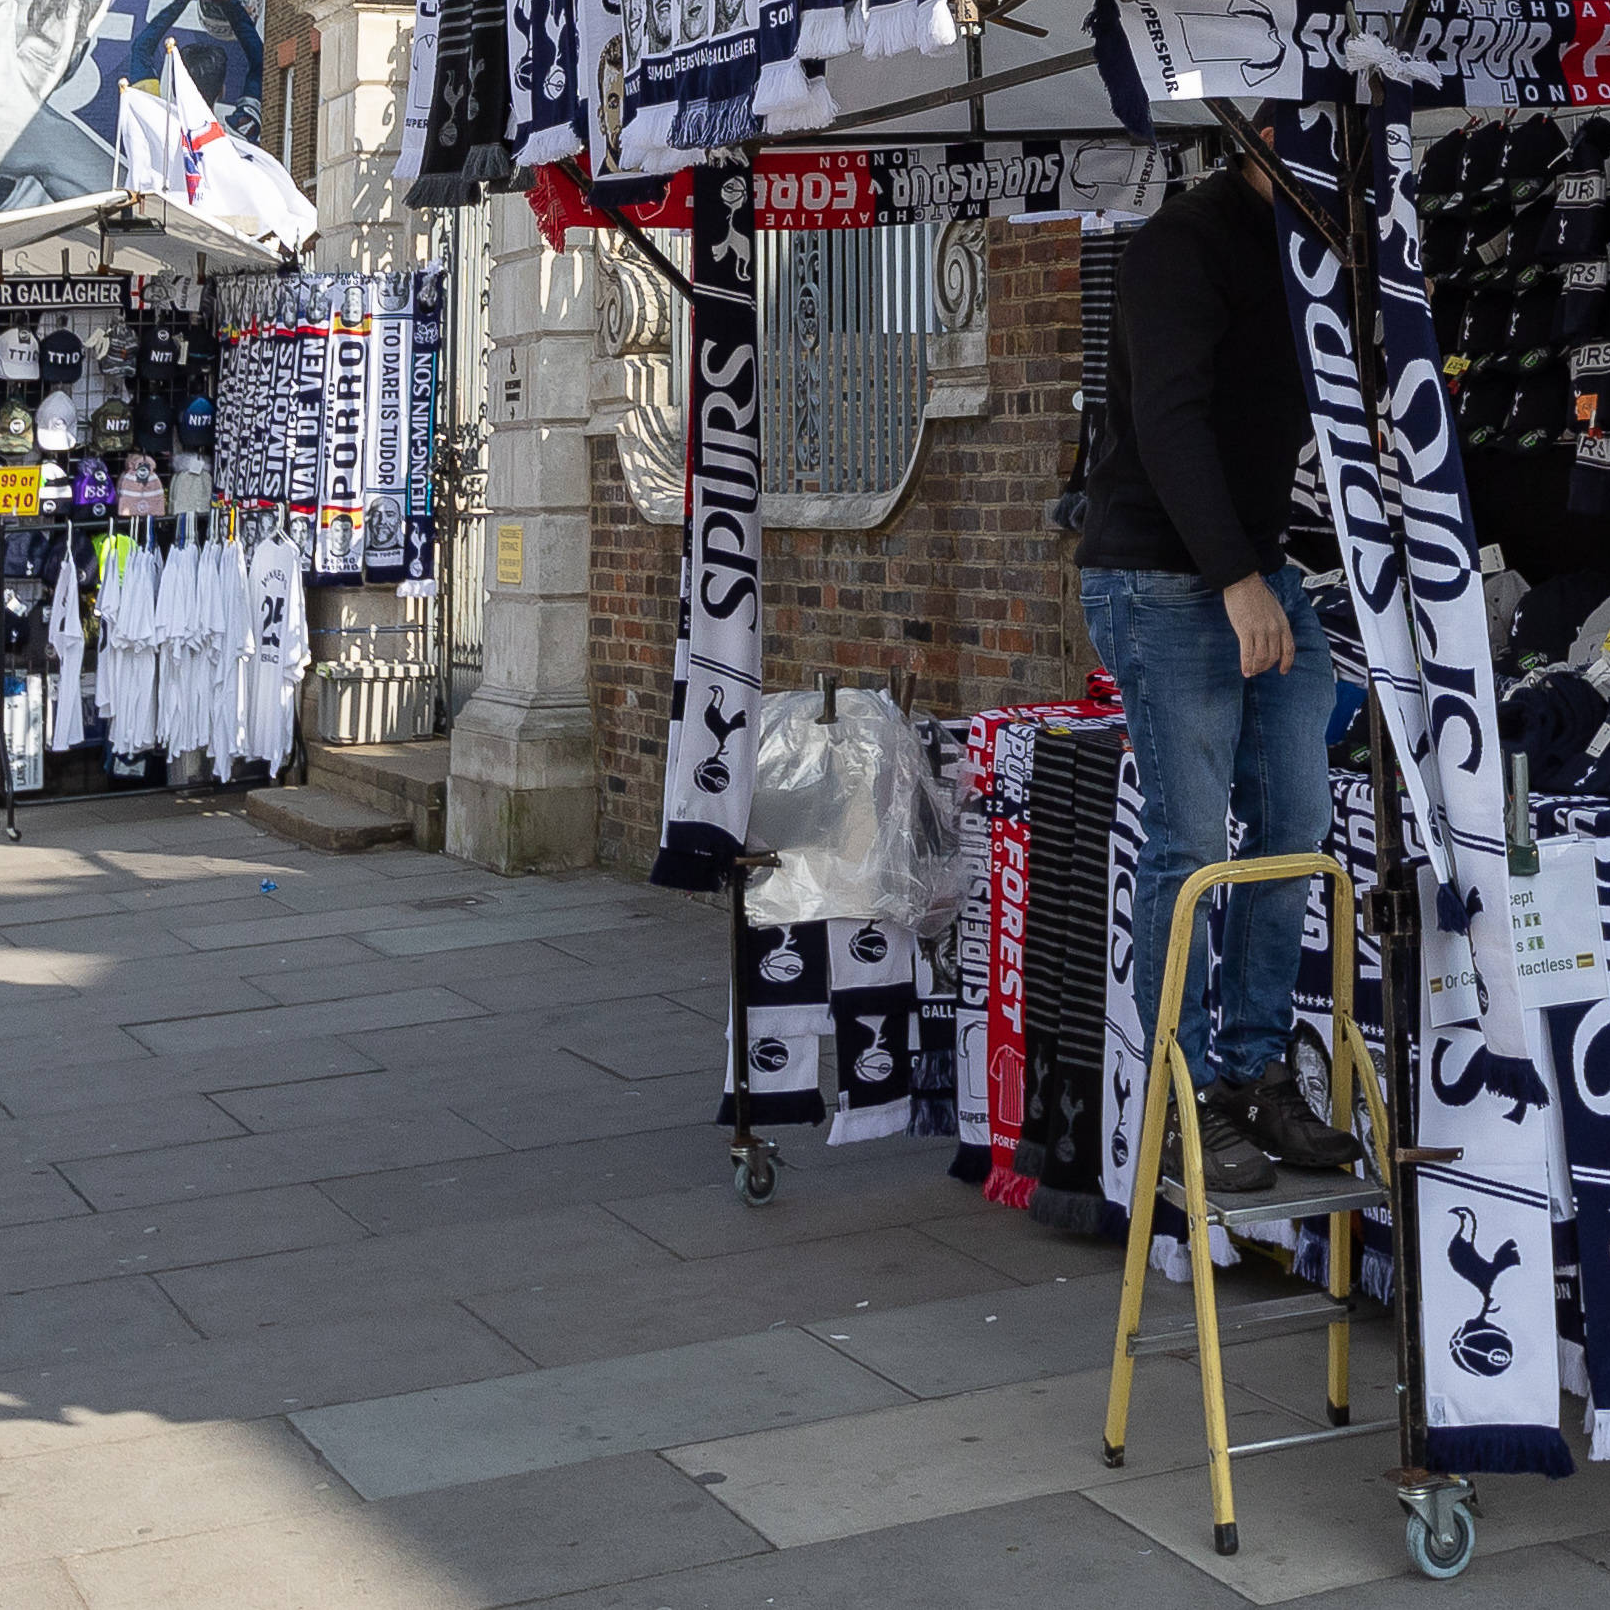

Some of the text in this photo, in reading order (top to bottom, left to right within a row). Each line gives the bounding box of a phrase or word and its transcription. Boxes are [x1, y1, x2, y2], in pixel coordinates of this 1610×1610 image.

[819, 150, 923, 172] LONDON
[17, 281, 123, 304] GALLAGHER
[21, 477, 35, 488] or
[263, 341, 295, 498] SIMONS
[286, 380, 300, 460] MICKY
[291, 338, 327, 503] VAN DE VEN
[330, 339, 366, 501] PORRO
[376, 322, 402, 486] TO DARE IS TUDOR
[410, 352, 433, 516] HEUNG-MIN SON
[1288, 229, 1399, 615] SPURS
[1, 492, 35, 509] £10
[700, 338, 759, 633] SPURS
[1390, 357, 1483, 778] SPURS
[997, 834, 1029, 1035] FOREST
[1444, 975, 1459, 988] Or
